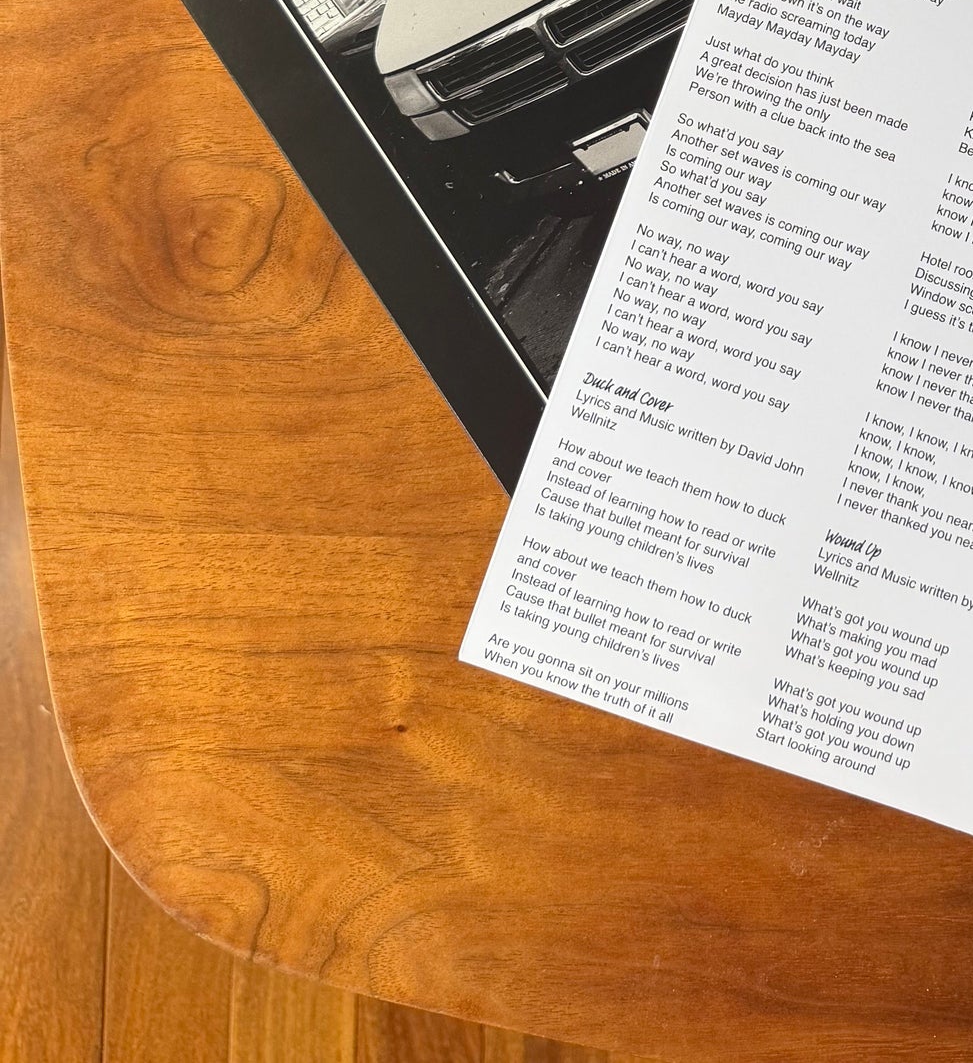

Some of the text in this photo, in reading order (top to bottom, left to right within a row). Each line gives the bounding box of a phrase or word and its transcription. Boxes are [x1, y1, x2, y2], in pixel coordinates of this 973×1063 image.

[717, 3, 861, 64] Mayday Mayday Mayday
[748, 0, 778, 16] radio
[780, 10, 841, 40] screaming
[843, 31, 876, 52] today
[920, 251, 952, 271] Hotel
[910, 282, 957, 308] Window
[582, 372, 674, 412] Duck and Cover
[541, 487, 750, 568] Cause that bullet meant for survival
[825, 529, 882, 562] Wound Up
[488, 633, 689, 711] Are you gonna sit on your millions
[756, 727, 876, 776] Start looking around
